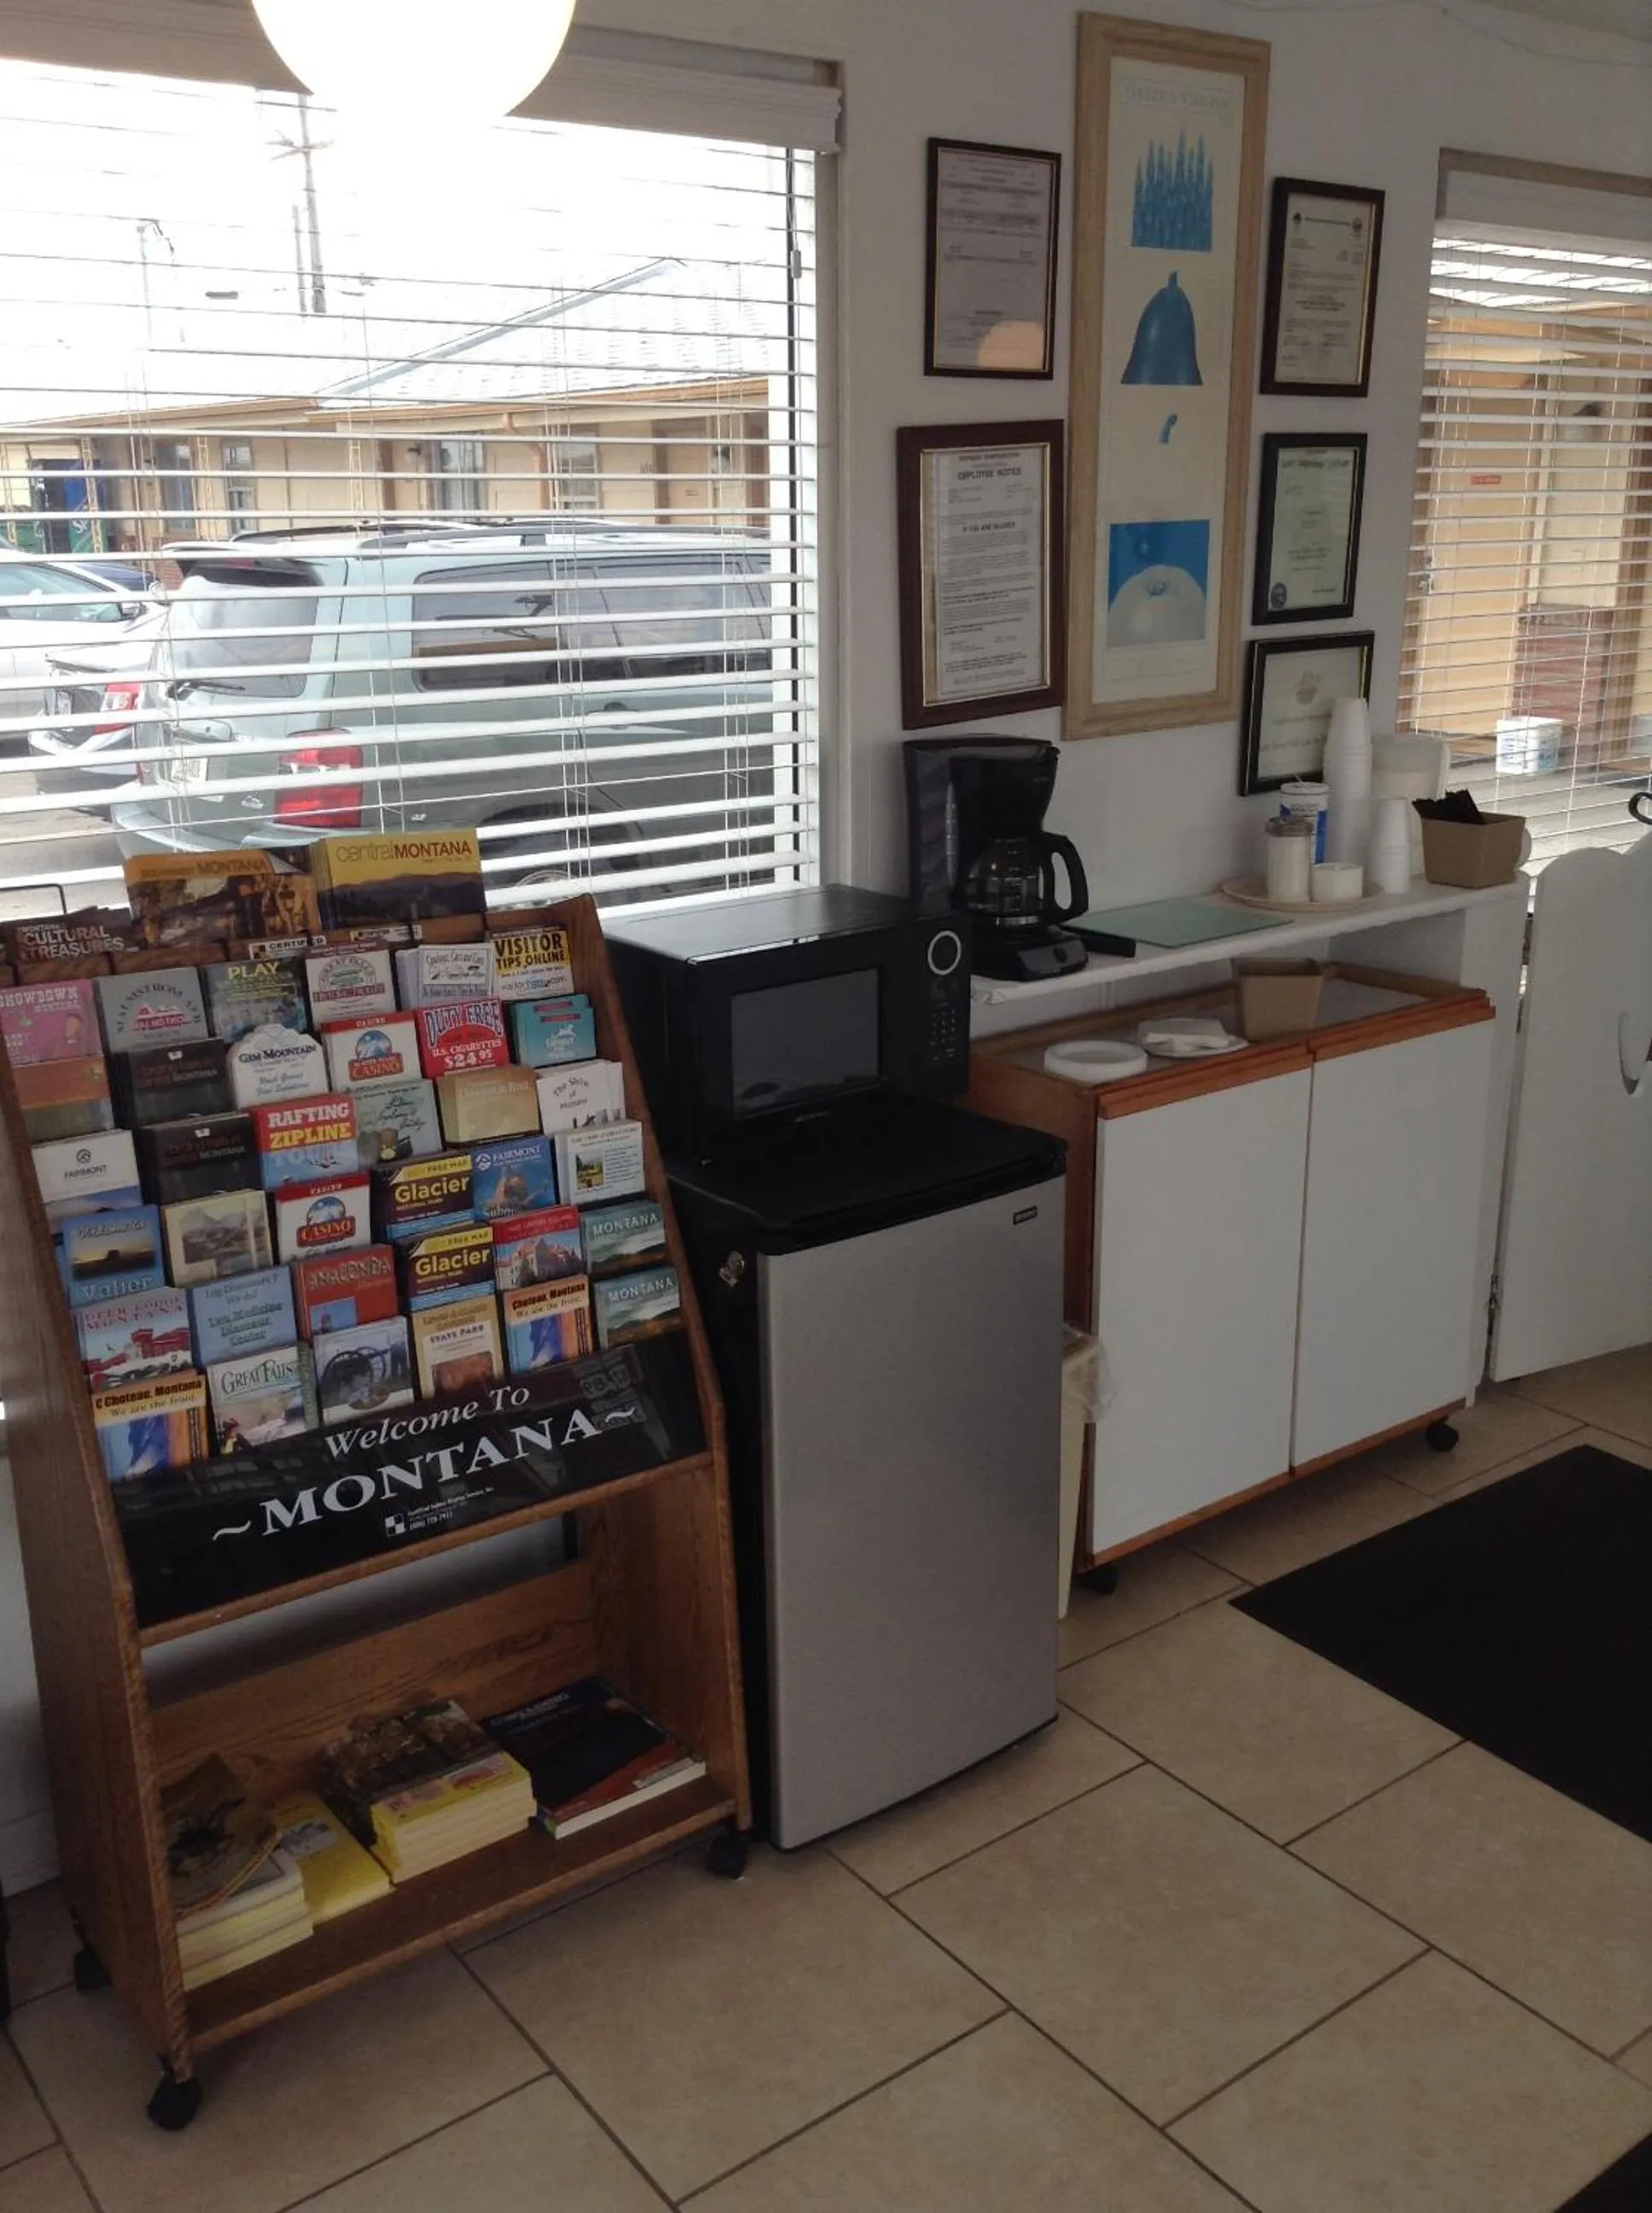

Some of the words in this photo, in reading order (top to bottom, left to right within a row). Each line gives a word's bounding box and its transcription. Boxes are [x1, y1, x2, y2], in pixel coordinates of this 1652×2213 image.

[24, 925, 109, 945] CULTURAL
[269, 937, 324, 950] CERTIFD
[494, 932, 563, 956] VISITOR
[26, 937, 125, 960] TREASURES
[495, 956, 521, 970] TIPS
[526, 949, 565, 966] ONLINE
[228, 961, 280, 980] PLAY
[424, 1007, 464, 1048] DUTY
[465, 1001, 504, 1038] FREE
[352, 1060, 400, 1079] CASINO
[267, 1102, 350, 1128] RAFTING
[269, 1122, 352, 1149] ZIPLINE
[394, 1177, 470, 1203] Glacier
[301, 1218, 351, 1240] CASINO
[593, 1212, 658, 1235] MONTANA
[415, 1247, 491, 1276] Glacier
[549, 1283, 585, 1299] Montana
[608, 1276, 674, 1302] MONTANA
[155, 1380, 202, 1396] Montana
[324, 1400, 478, 1459] Welcome
[488, 1385, 530, 1410] To
